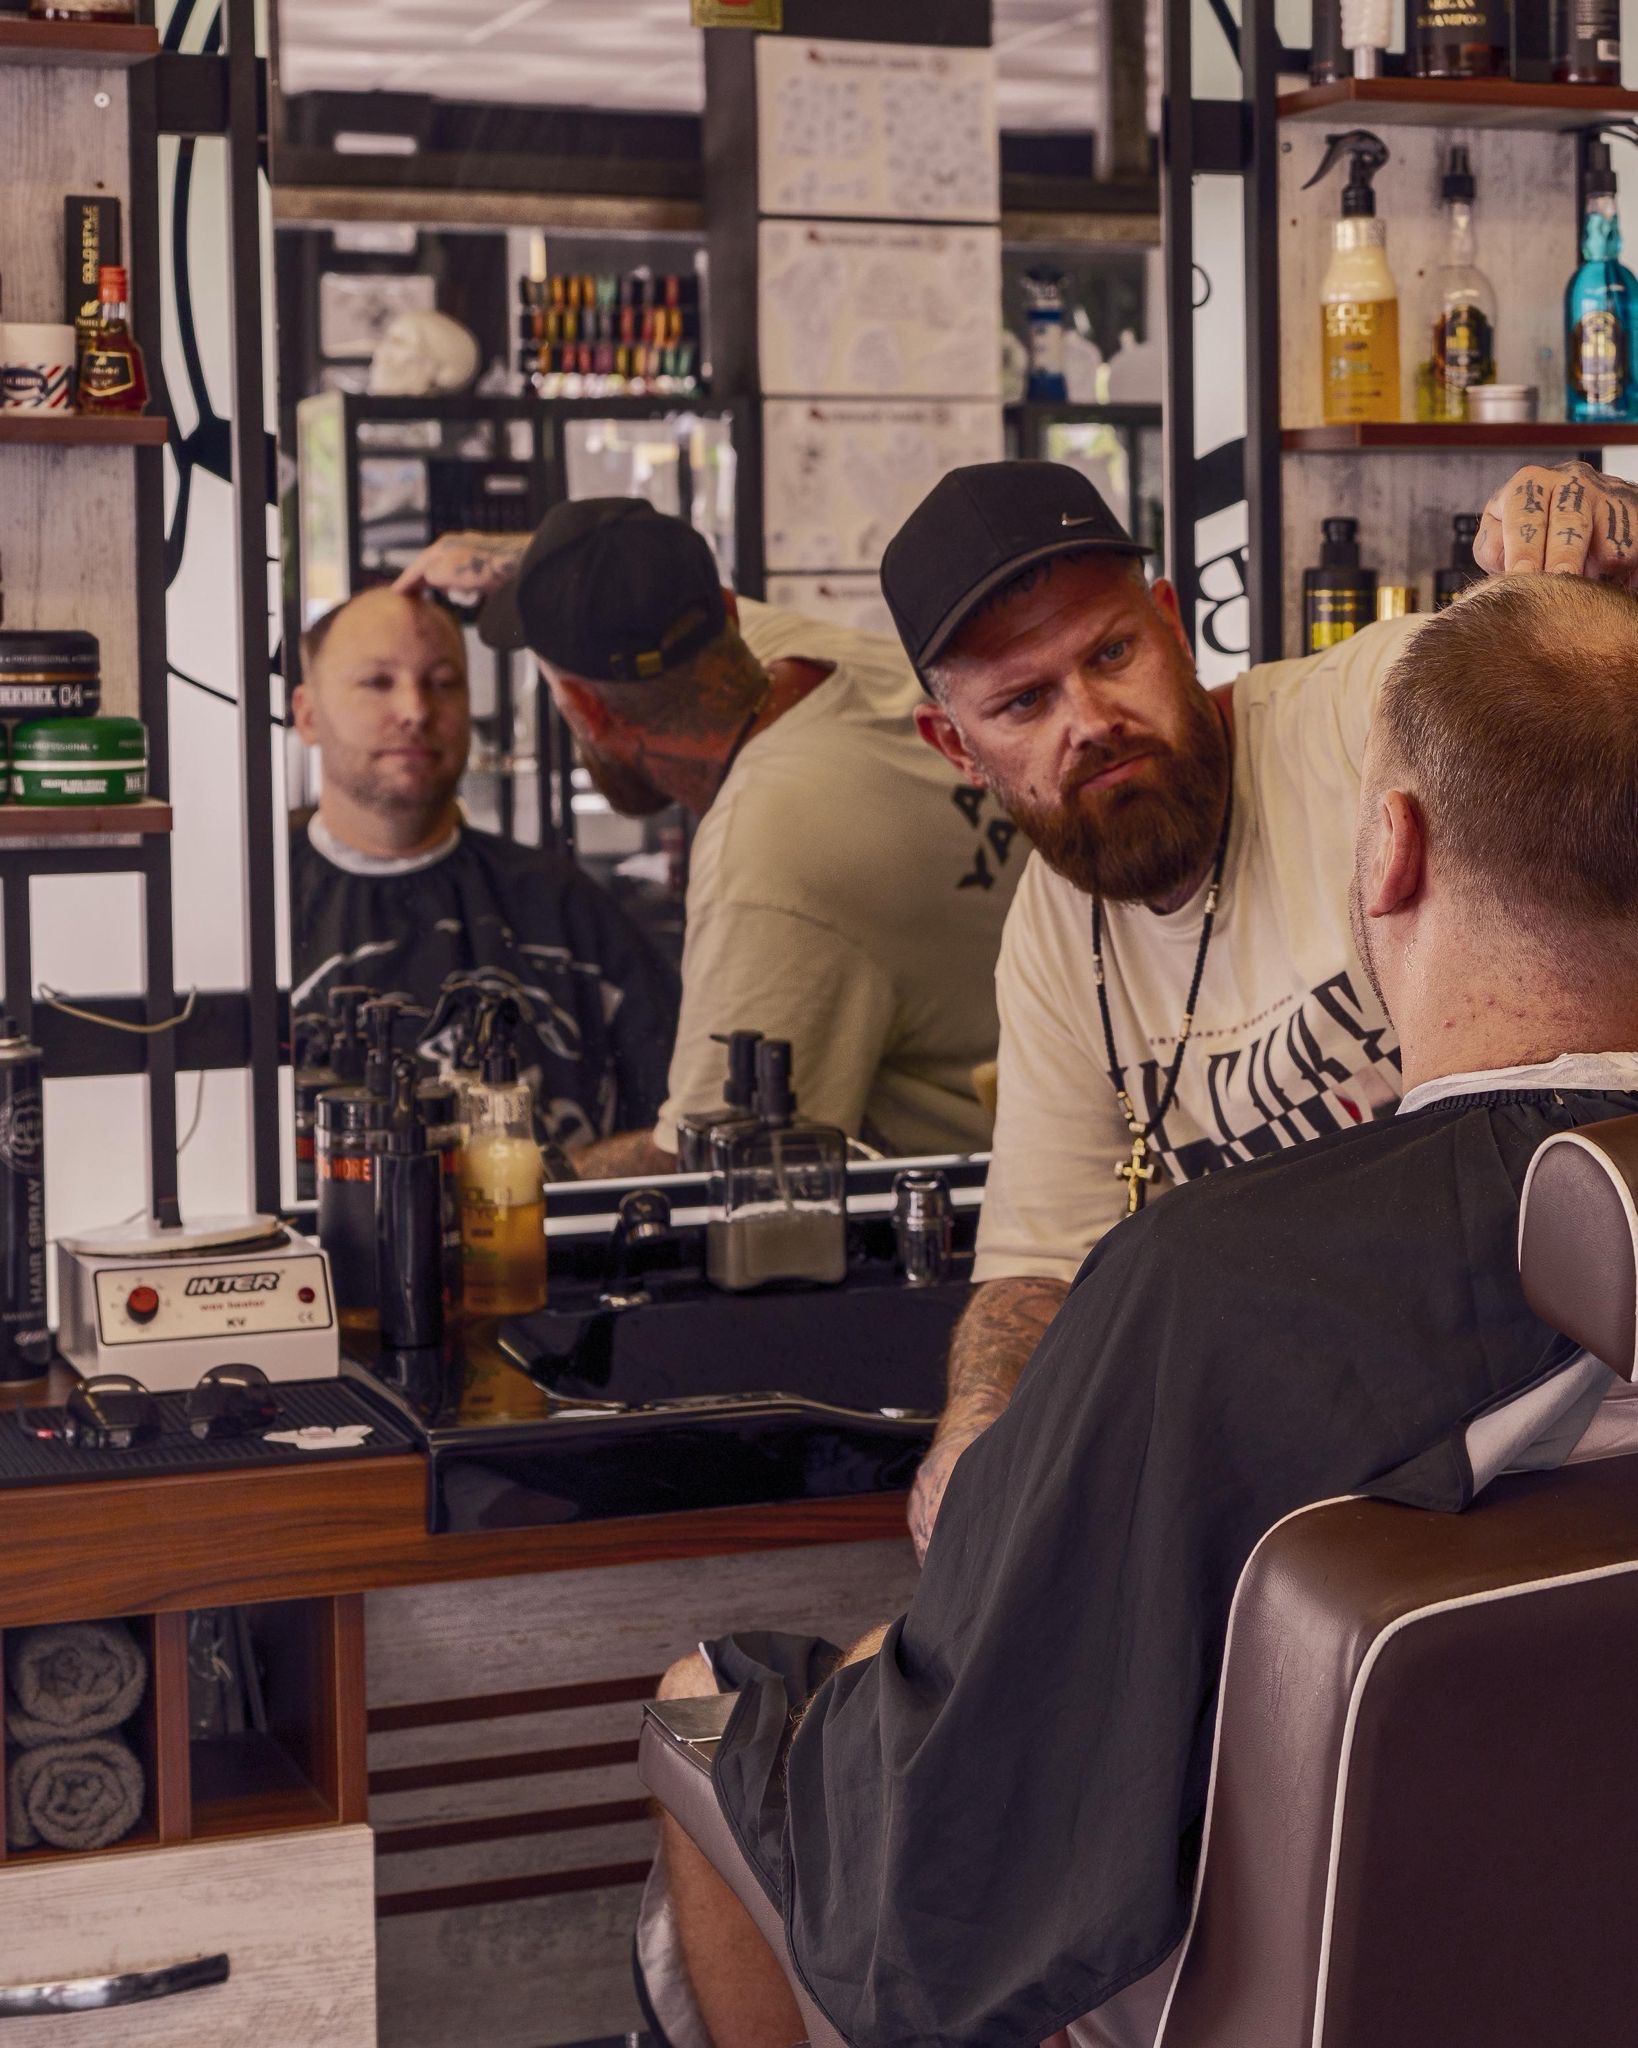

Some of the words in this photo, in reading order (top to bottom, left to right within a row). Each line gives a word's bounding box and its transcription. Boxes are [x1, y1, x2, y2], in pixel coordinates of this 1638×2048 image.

[28, 1178, 42, 1248] SPRAY
[30, 1254, 42, 1301] HAIR
[184, 1272, 280, 1296] INTER
